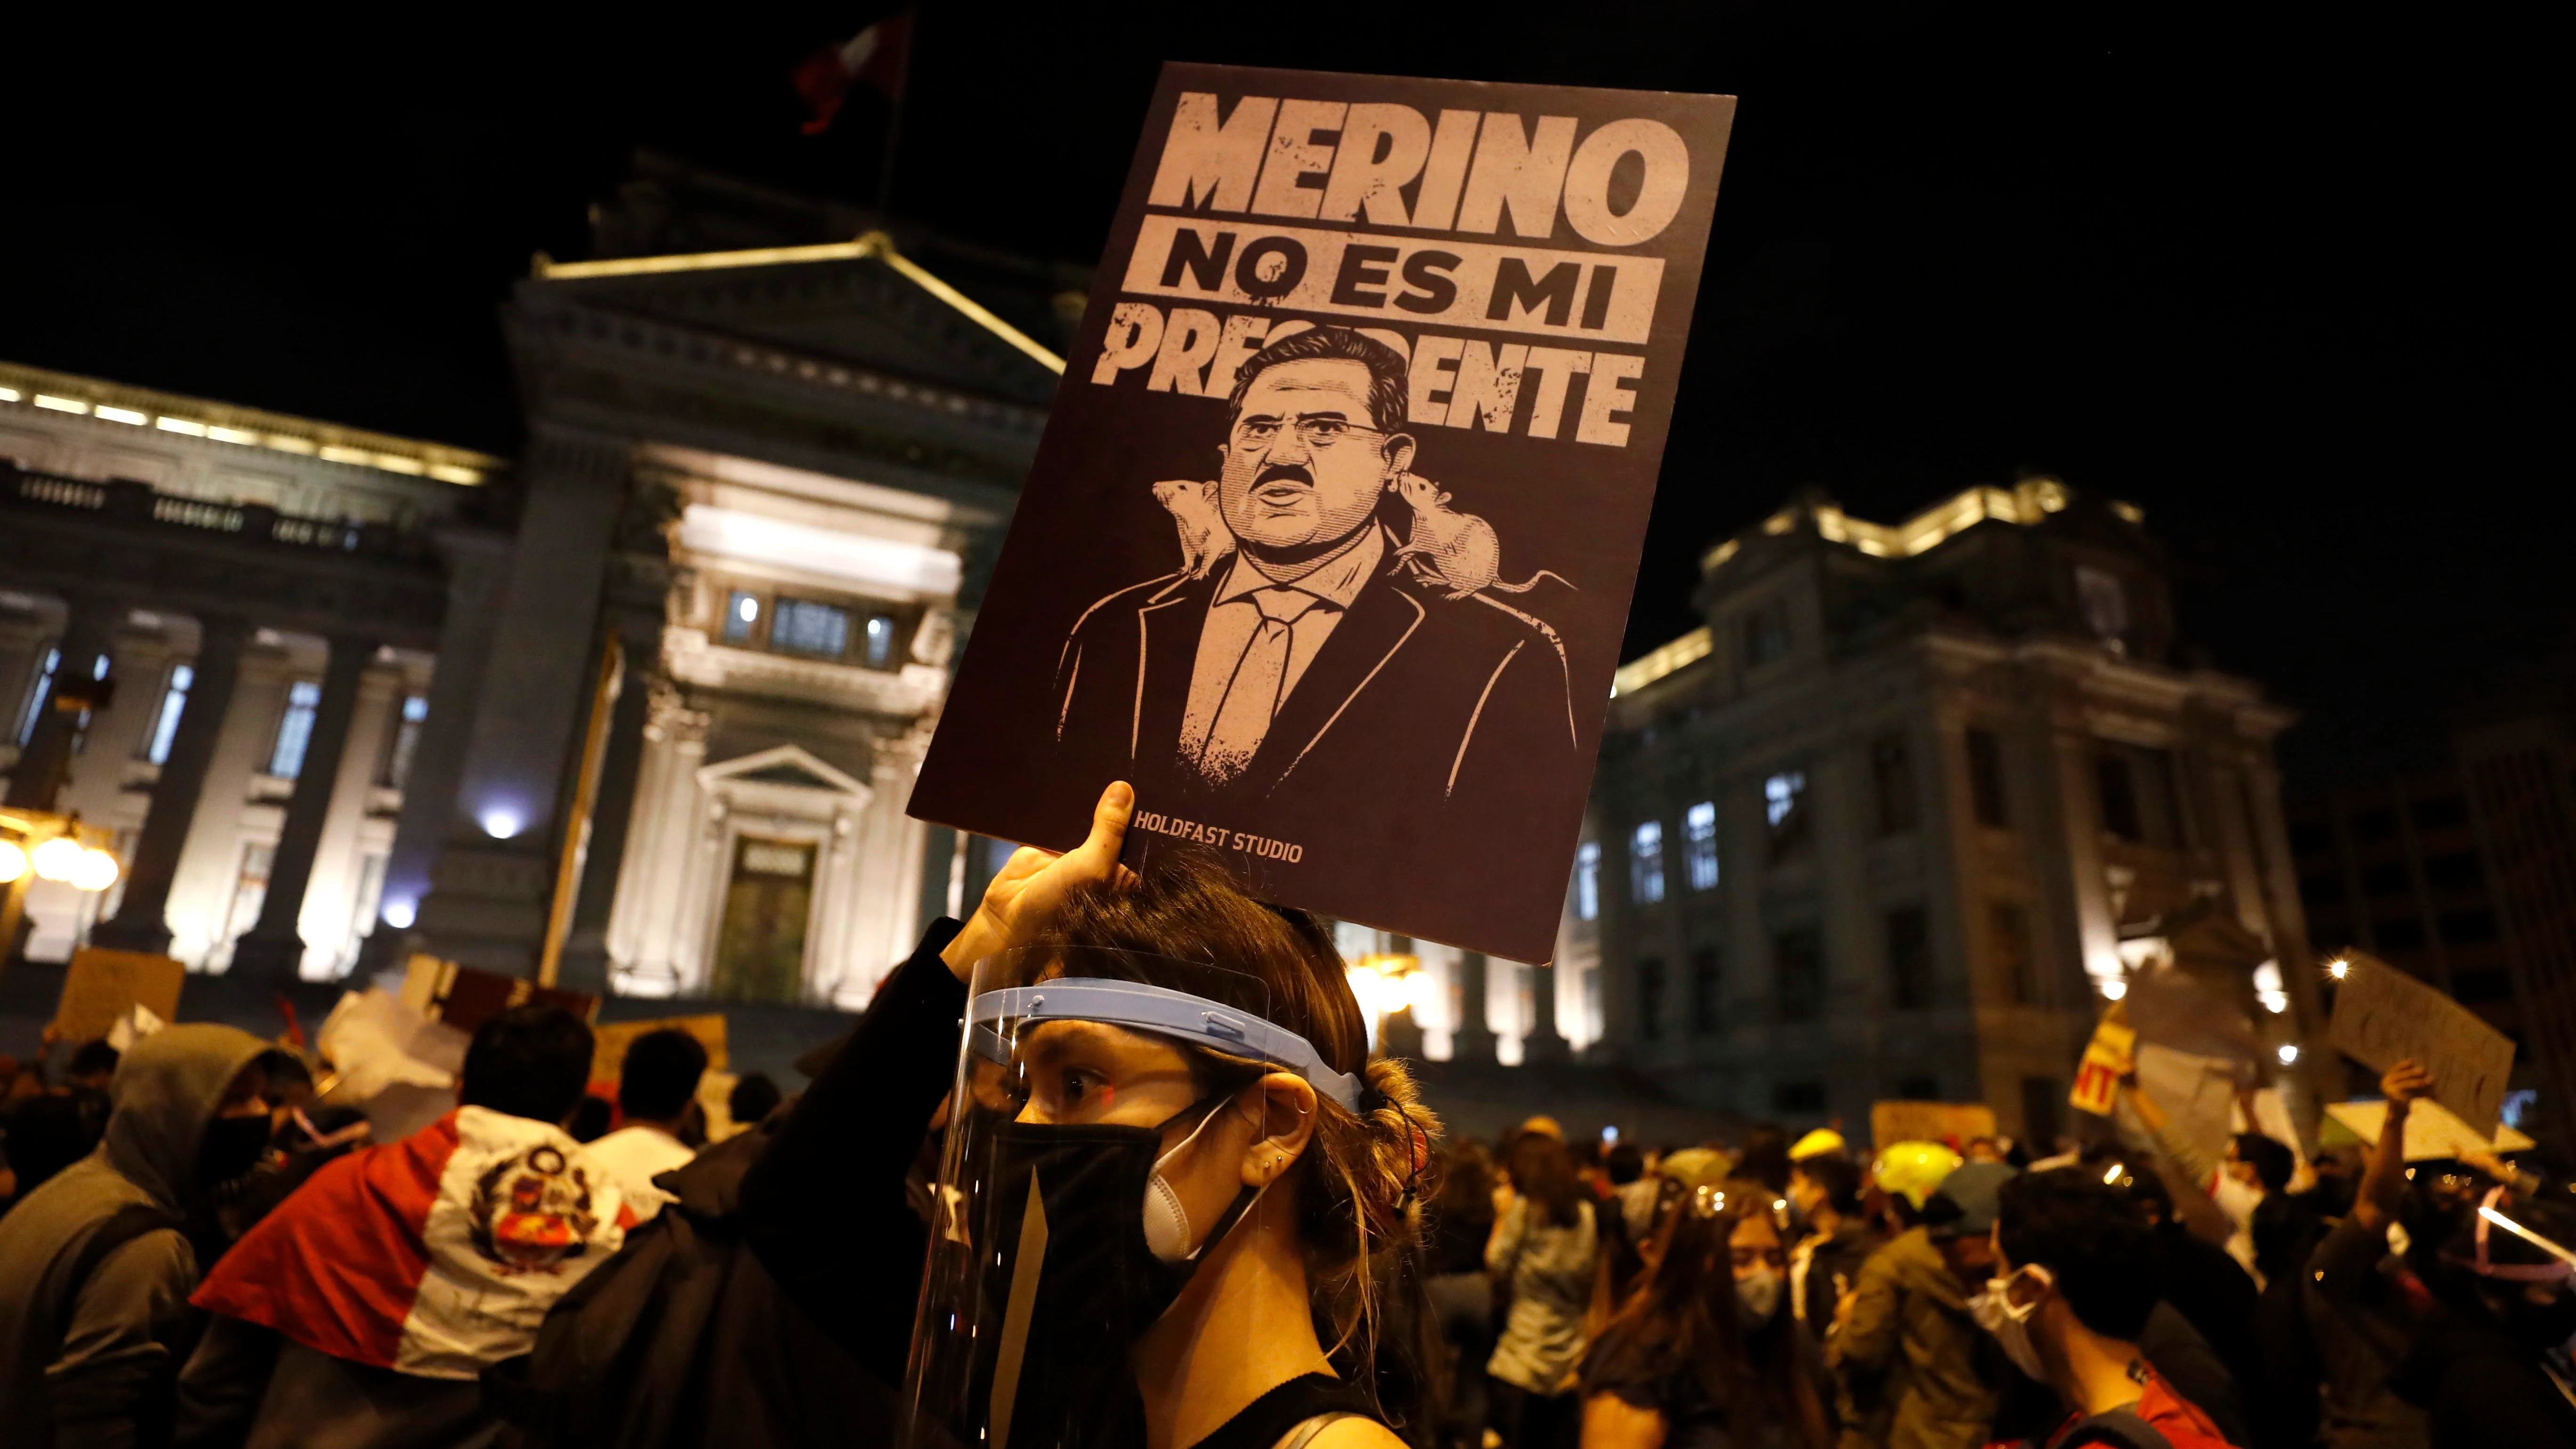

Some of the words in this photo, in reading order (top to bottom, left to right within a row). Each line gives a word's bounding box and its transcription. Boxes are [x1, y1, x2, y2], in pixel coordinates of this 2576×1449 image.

[1147, 91, 1690, 247] MERINO
[1159, 228, 1308, 298] NO
[1330, 243, 1463, 314] ES
[1486, 257, 1621, 330] MI
[1091, 302, 1646, 448] PREENTE
[1134, 810, 1230, 847] HOLDFAST
[1232, 832, 1303, 863] STUDIO
